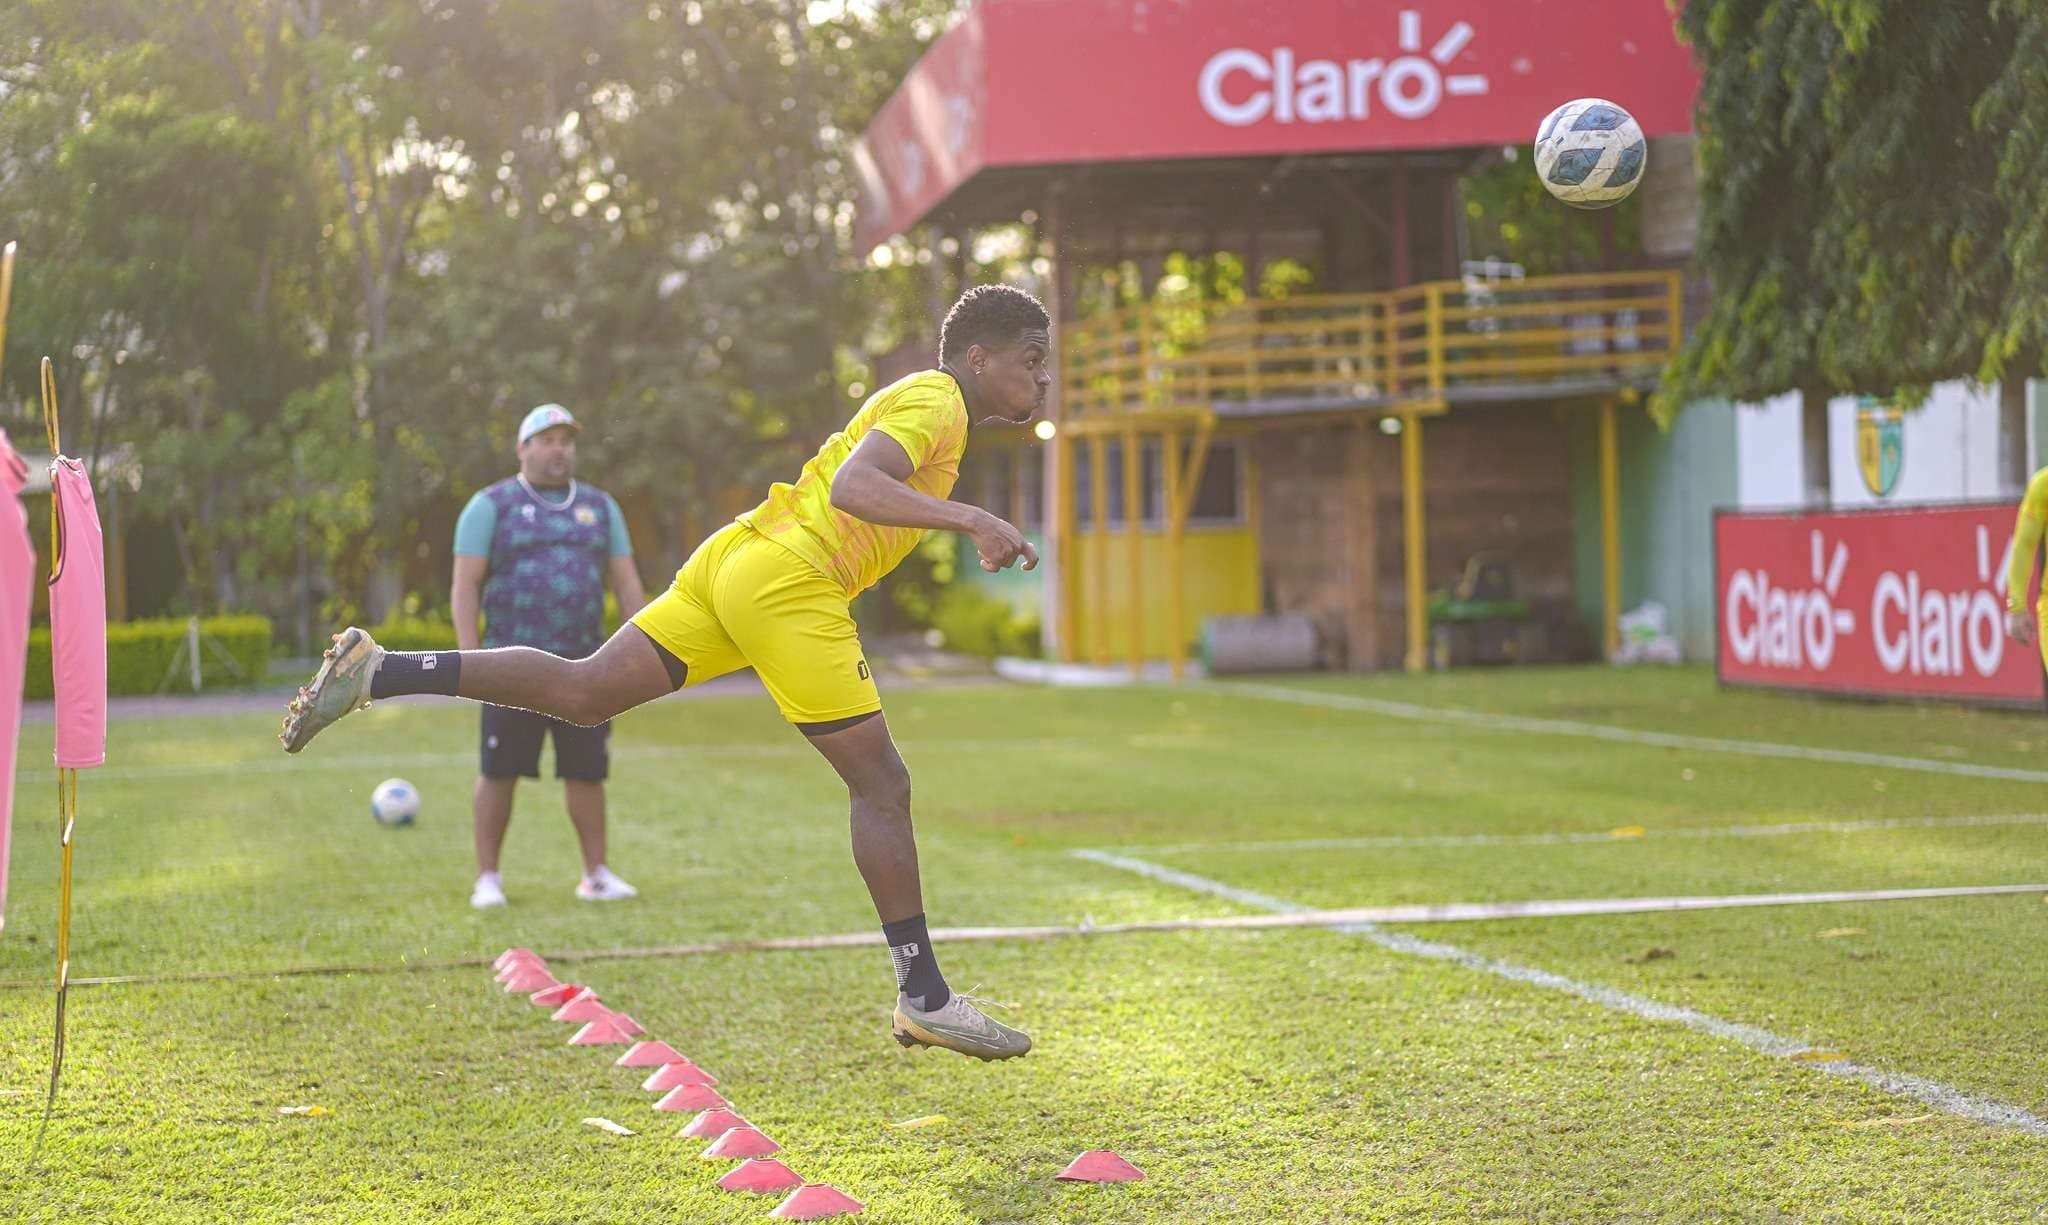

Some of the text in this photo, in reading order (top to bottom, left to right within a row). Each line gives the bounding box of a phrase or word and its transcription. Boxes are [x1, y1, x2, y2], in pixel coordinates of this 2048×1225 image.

[1198, 47, 1441, 126] Claro
[1726, 568, 2003, 677] Claro Claro
